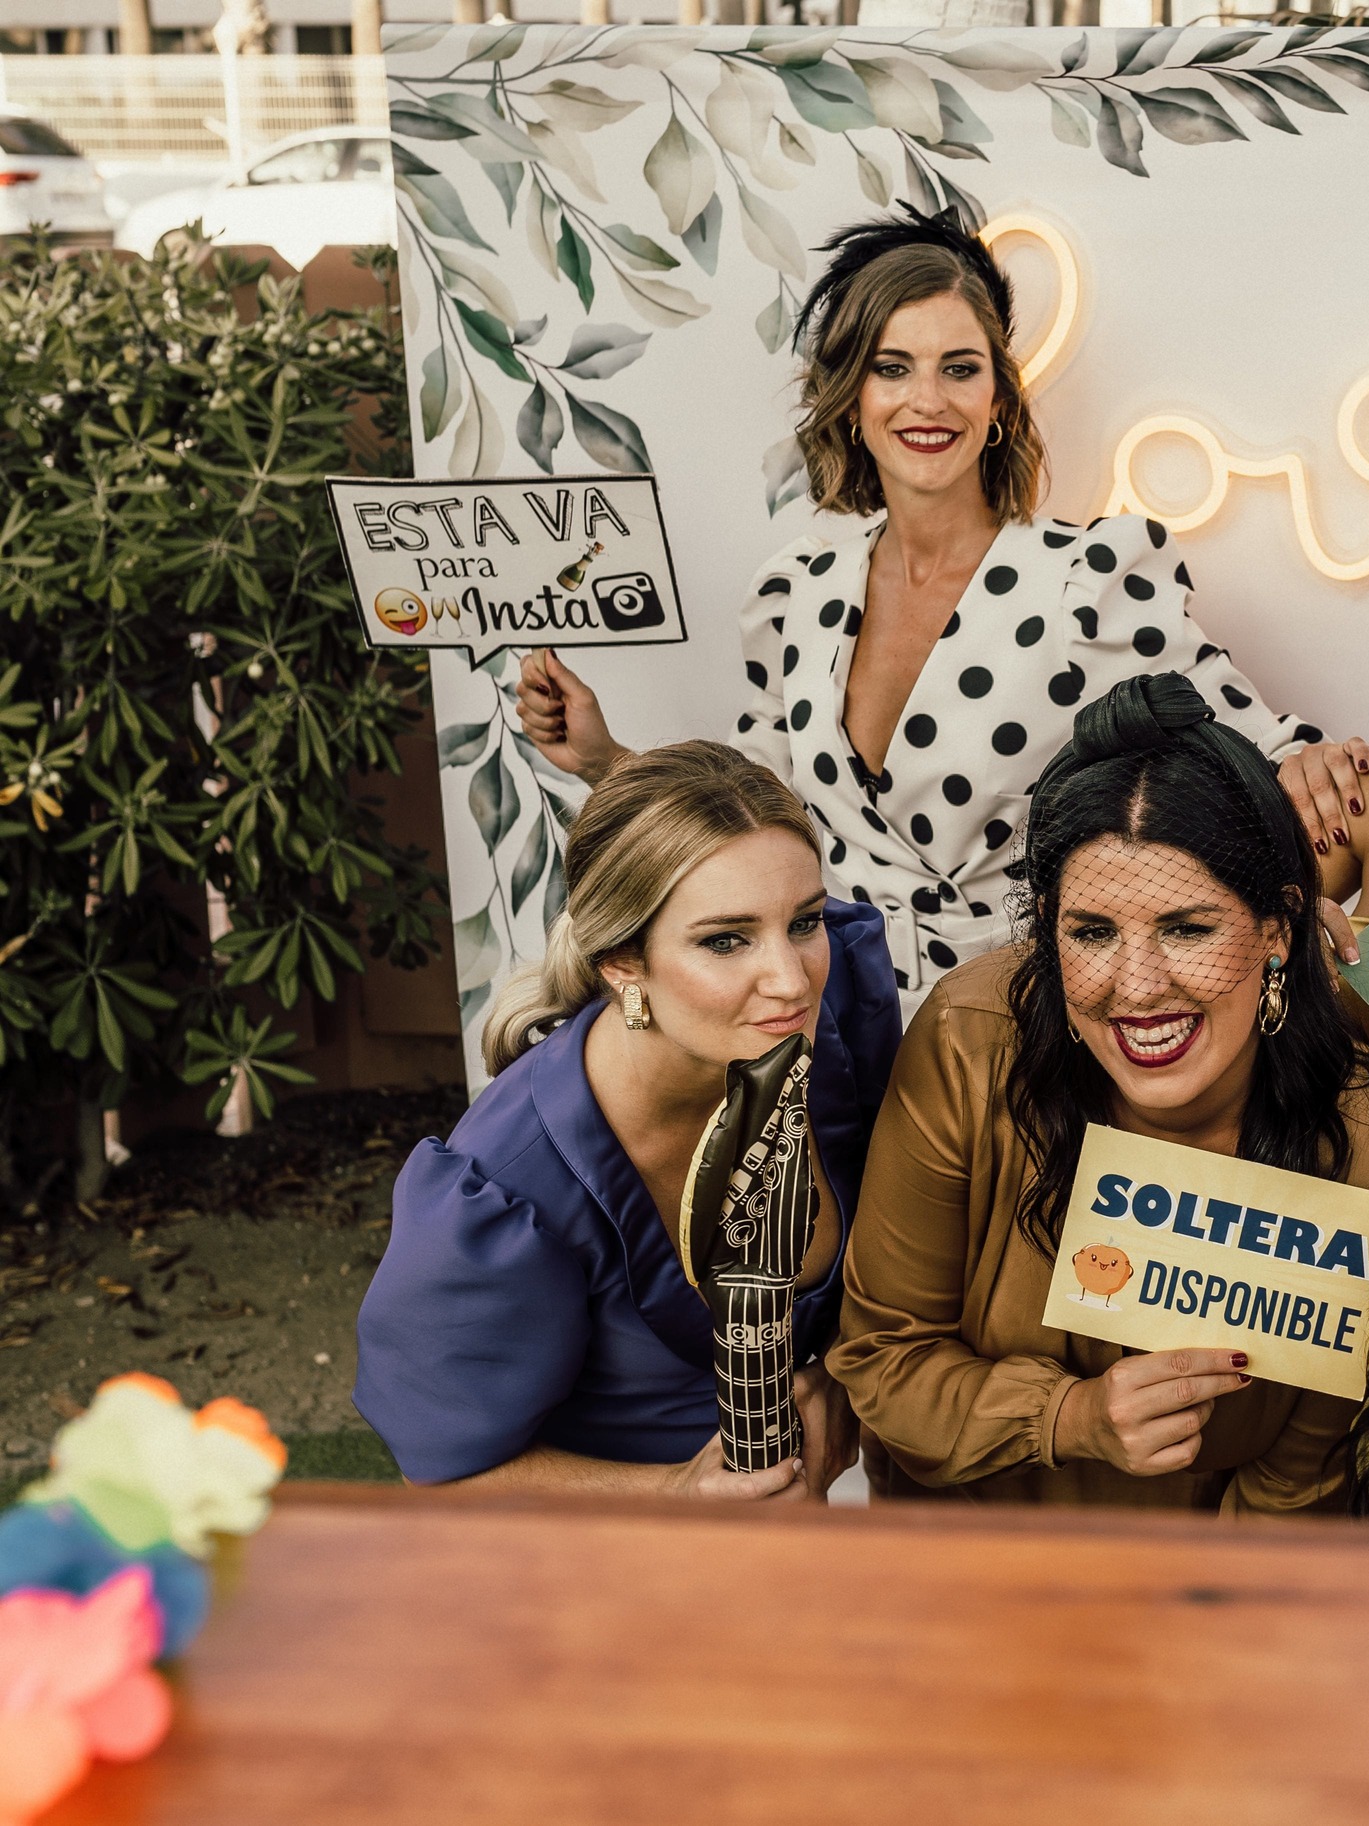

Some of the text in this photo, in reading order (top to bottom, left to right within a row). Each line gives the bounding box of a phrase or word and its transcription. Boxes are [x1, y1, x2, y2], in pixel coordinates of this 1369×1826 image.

[354, 487, 630, 552] ESTA VA
[414, 557, 499, 592] para
[462, 585, 599, 637] Insta
[1138, 1259, 1362, 1354] DISPONIBLE
